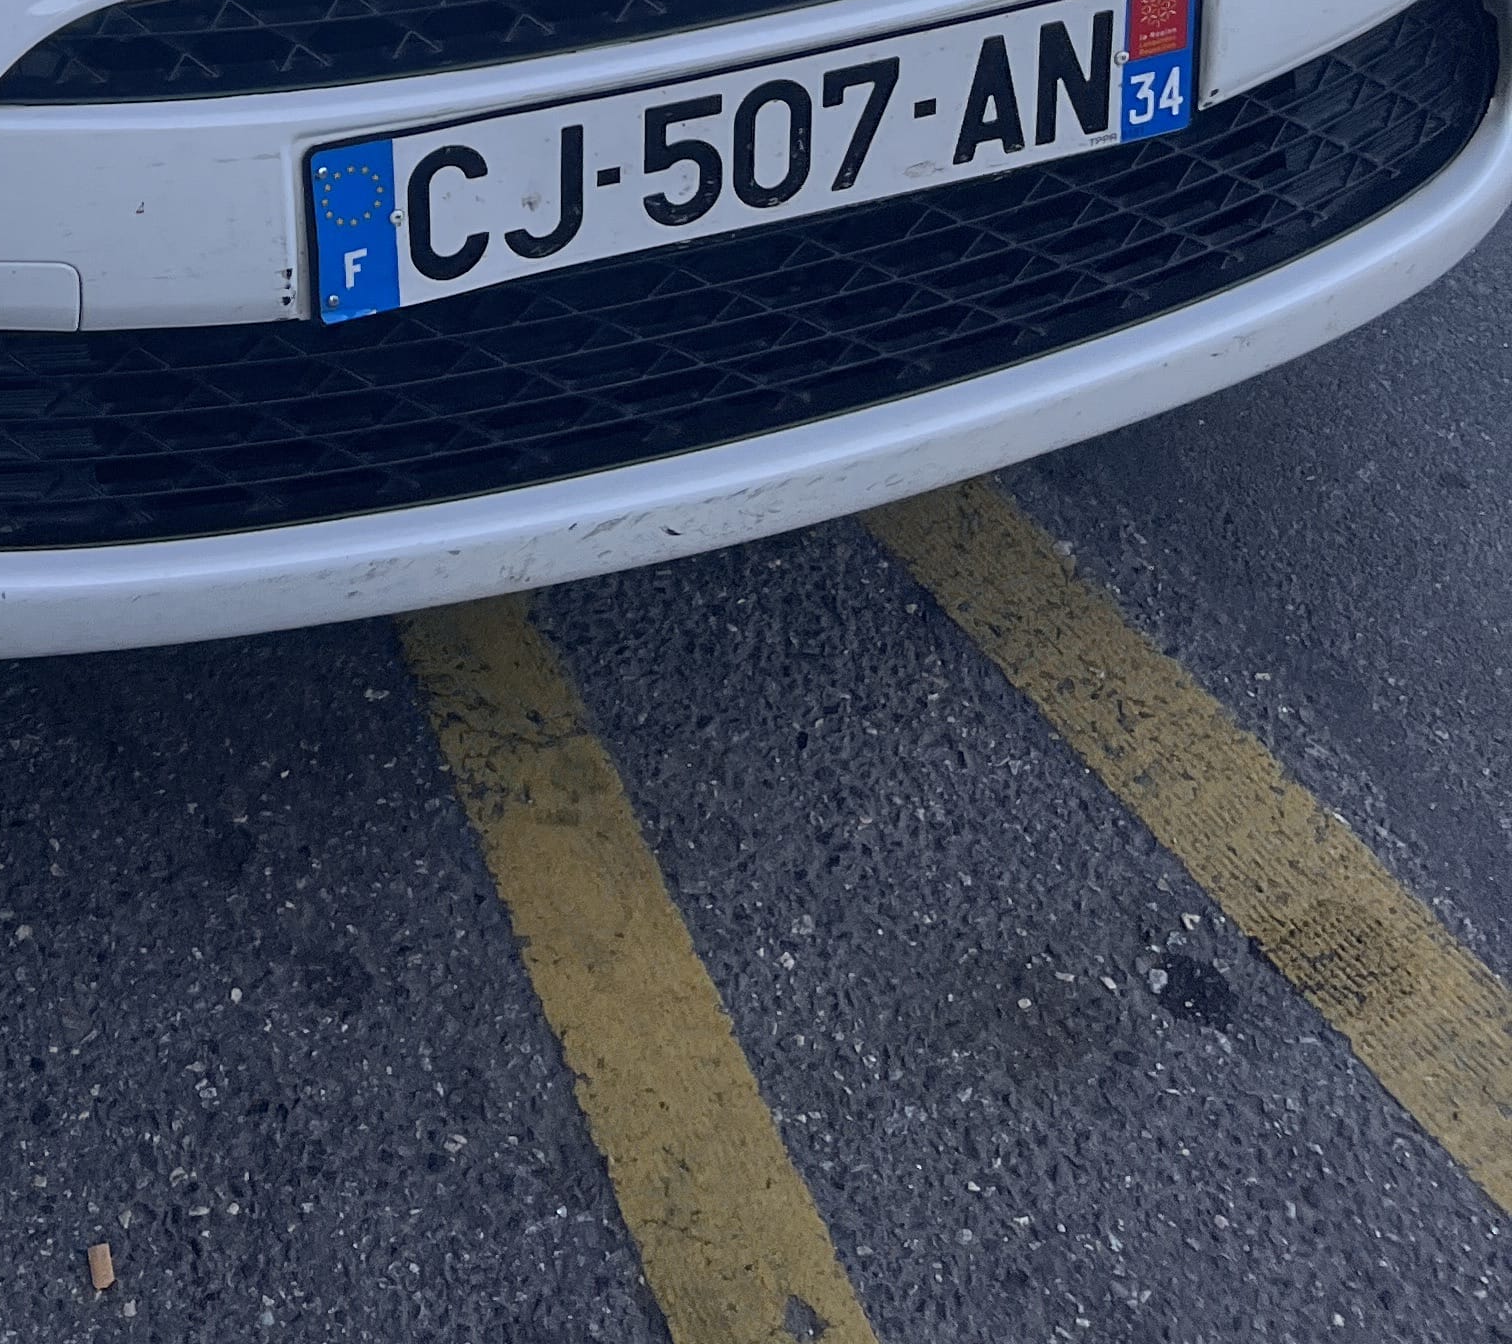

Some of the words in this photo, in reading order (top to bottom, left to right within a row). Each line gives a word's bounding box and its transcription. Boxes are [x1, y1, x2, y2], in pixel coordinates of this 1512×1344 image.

[343, 248, 368, 290] F
[407, 10, 1114, 281] CJ-507-AN
[1129, 66, 1184, 125] 34
